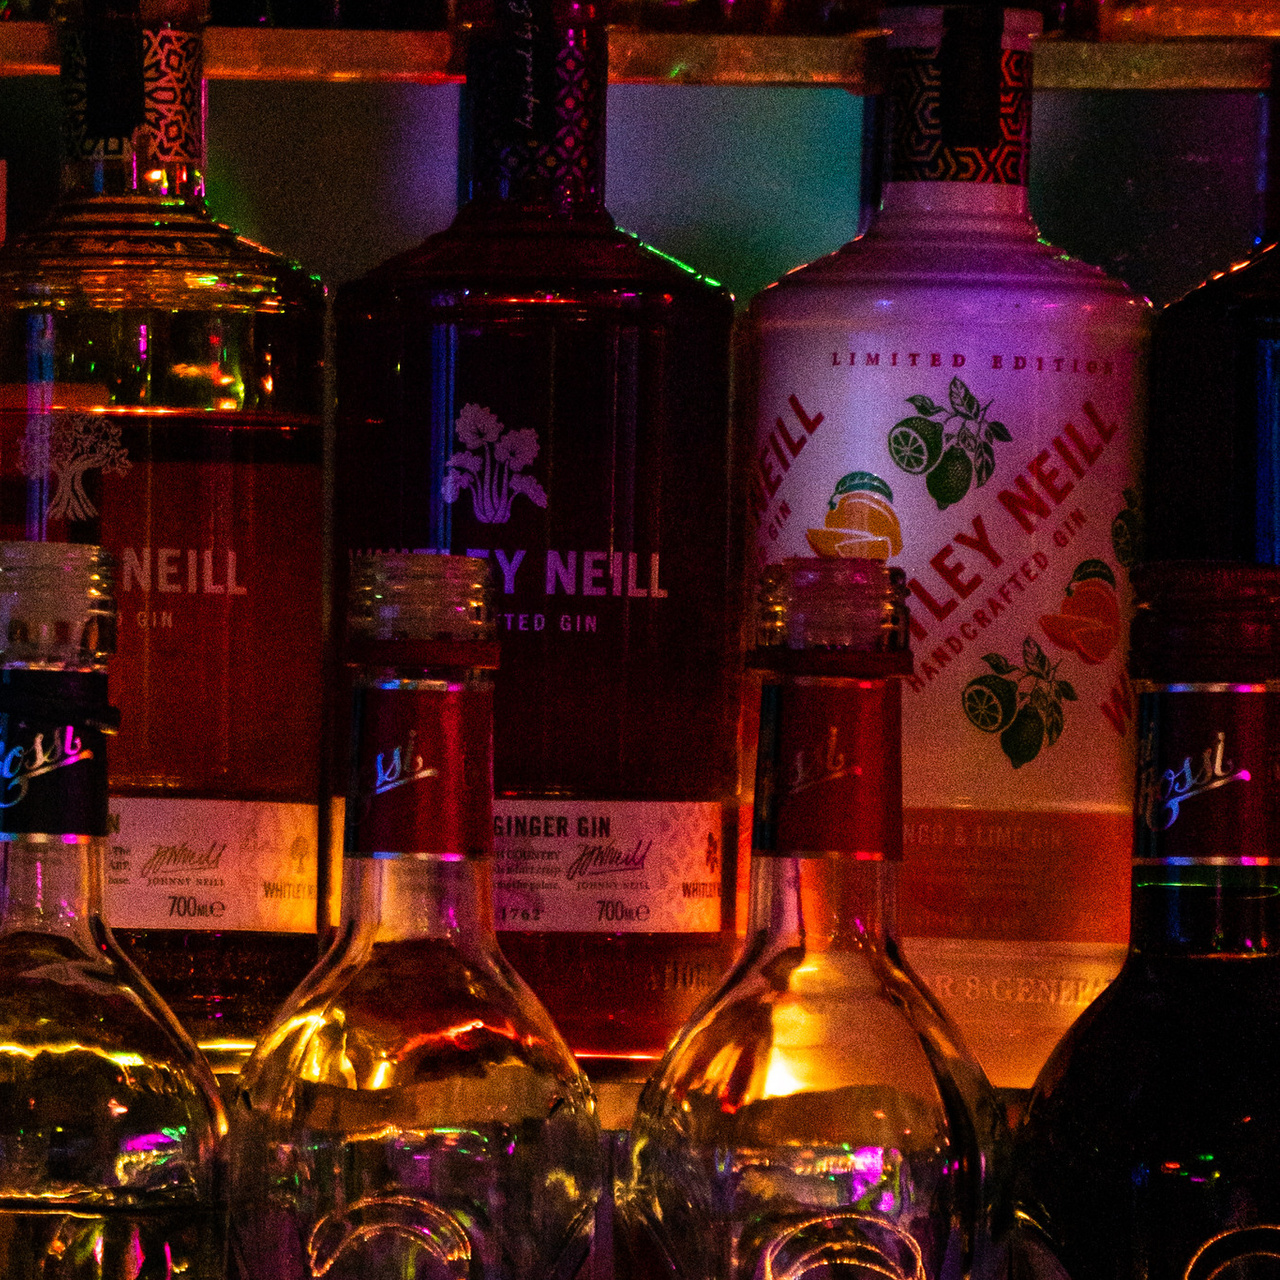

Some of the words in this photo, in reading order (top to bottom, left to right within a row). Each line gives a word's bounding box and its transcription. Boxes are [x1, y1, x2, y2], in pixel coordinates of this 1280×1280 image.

[832, 352, 967, 369] LIMITED
[991, 354, 1117, 375] EDITION
[997, 400, 1119, 538] NEILL
[122, 546, 248, 596] NEILL
[545, 549, 669, 599] NEILL
[905, 550, 1050, 694] HANDCRAFTED
[1051, 506, 1088, 550] GIN
[136, 610, 175, 629] GIN
[559, 613, 599, 634] GIN
[493, 816, 569, 838] GINGER
[577, 816, 611, 839] GIN
